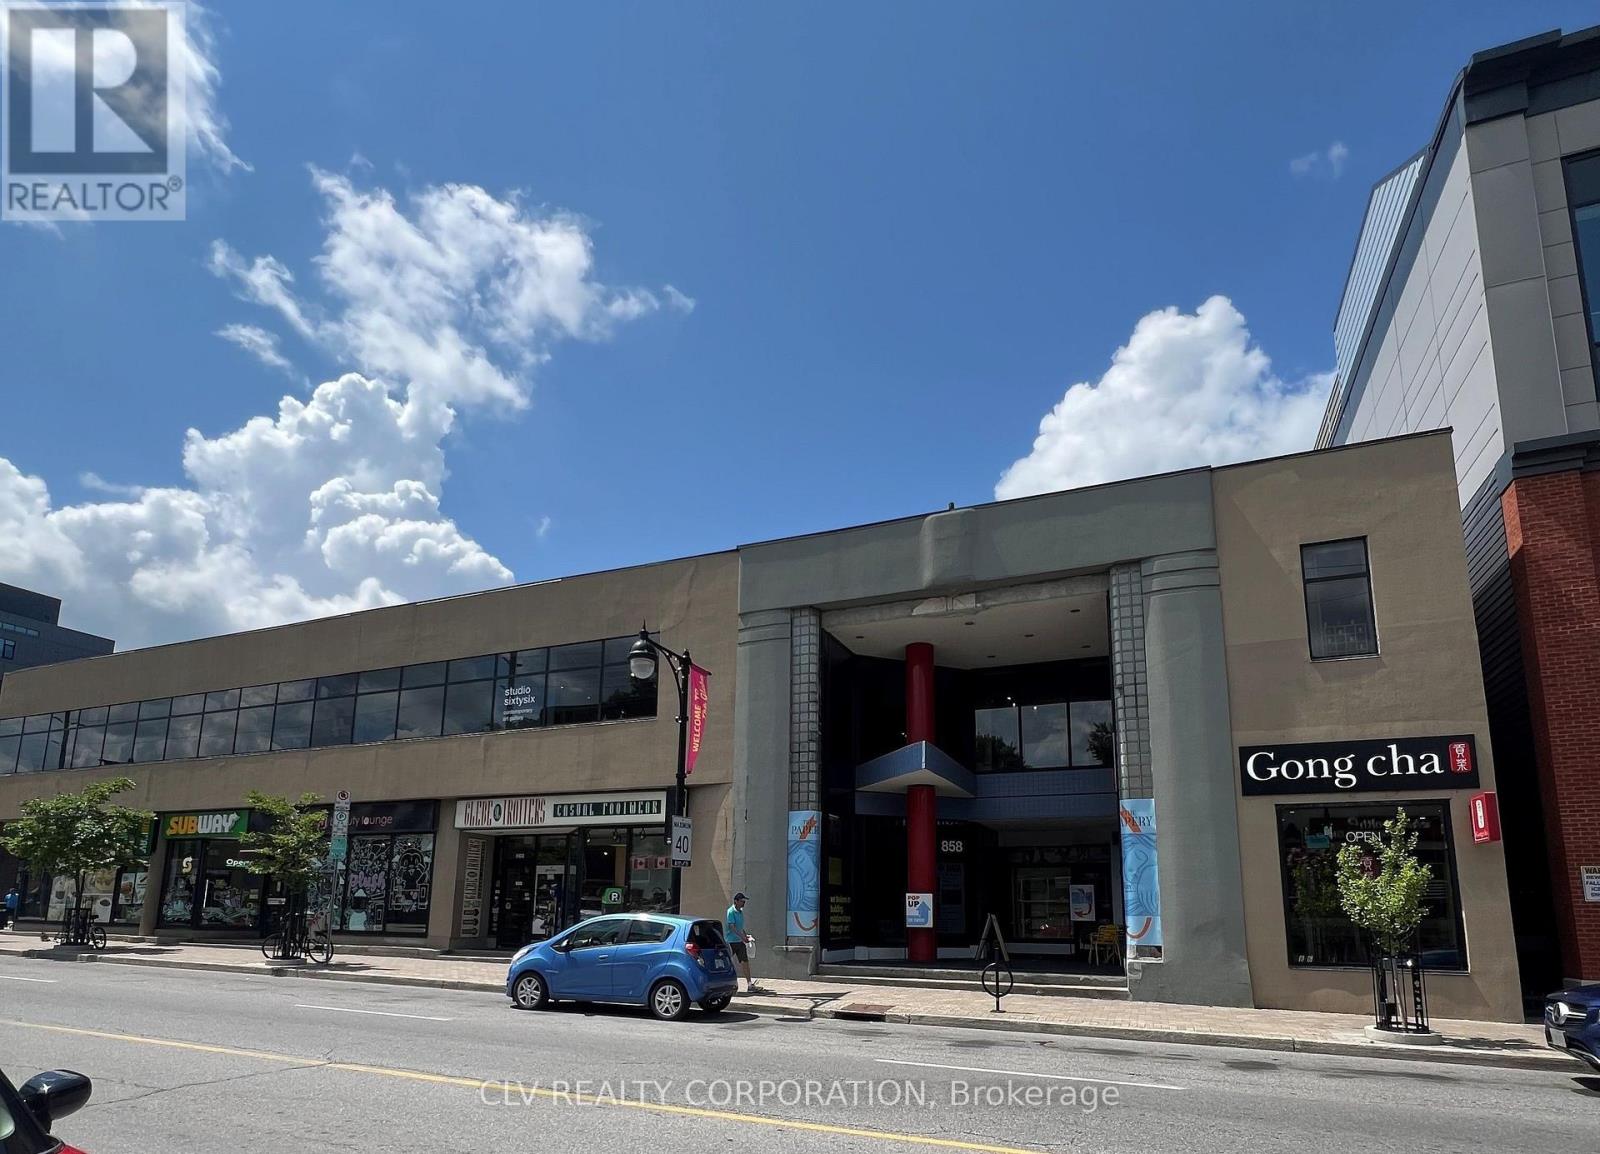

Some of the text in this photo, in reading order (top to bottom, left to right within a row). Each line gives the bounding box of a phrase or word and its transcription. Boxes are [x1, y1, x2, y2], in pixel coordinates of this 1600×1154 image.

[504, 685, 531, 696] studio
[504, 695, 536, 706] sixtysix
[692, 704, 701, 752] WELCOME
[1246, 743, 1445, 789] Gong cha
[556, 800, 658, 817] CASUAL FOOTWEAR
[167, 812, 240, 836] SUBWAY
[361, 815, 393, 827] lounge
[1345, 831, 1382, 843] OPEN
[675, 835, 689, 854] 40
[941, 840, 963, 852] 858
[907, 900, 920, 908] UP
